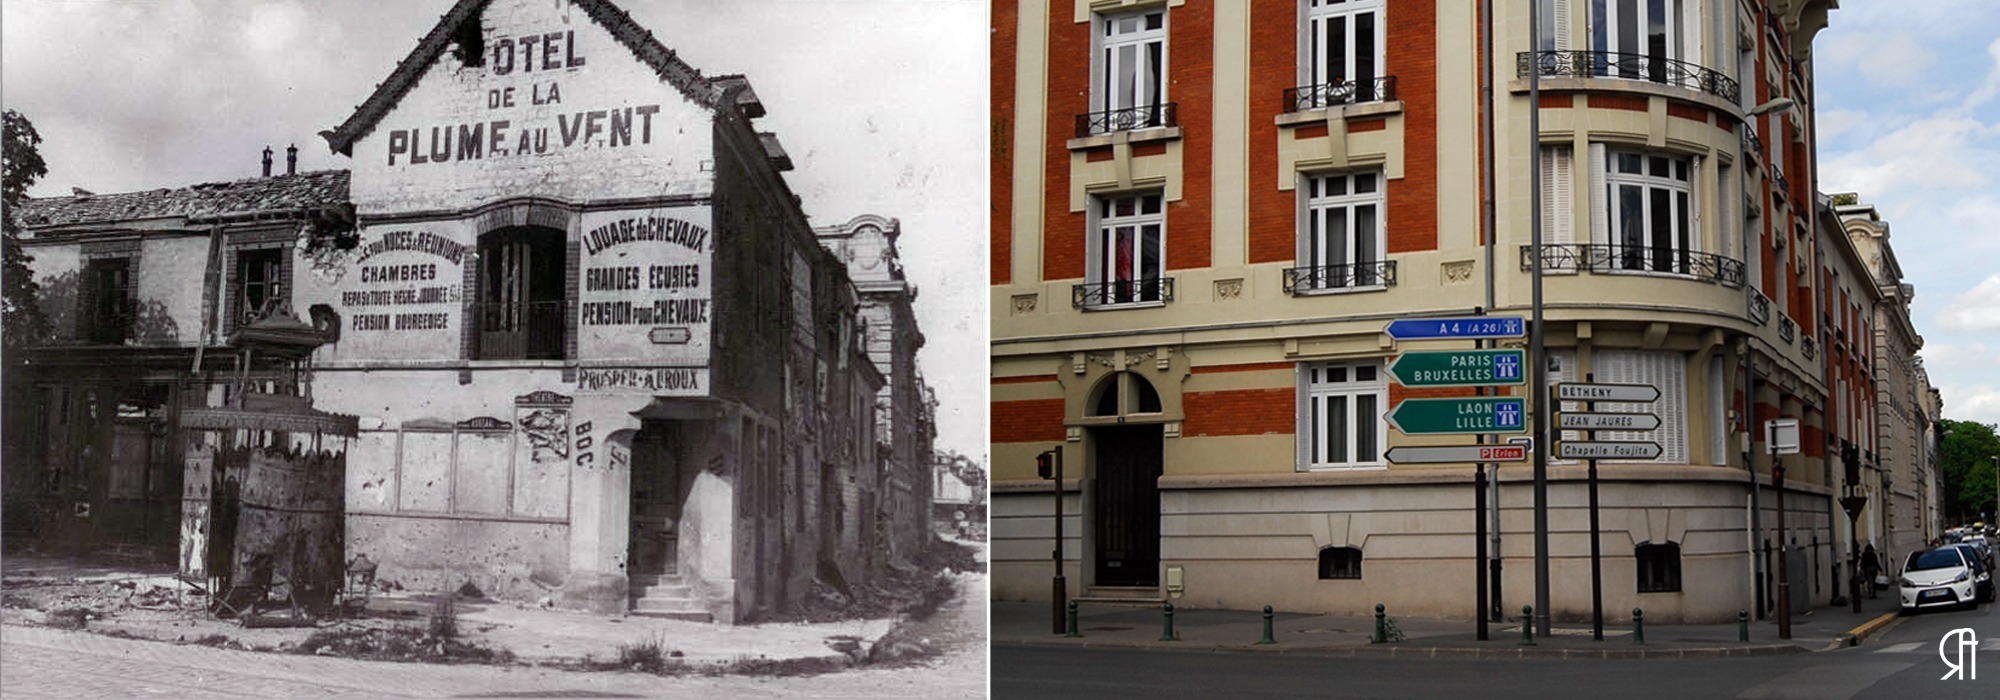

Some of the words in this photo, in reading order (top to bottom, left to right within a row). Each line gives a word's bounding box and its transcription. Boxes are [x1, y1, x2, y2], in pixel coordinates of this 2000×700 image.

[488, 87, 516, 109] DE
[532, 82, 561, 105] LA
[388, 120, 510, 166] PLUME
[517, 127, 548, 155] AU
[558, 104, 660, 149] VENT
[583, 219, 637, 256] LOUAGE
[647, 216, 709, 253] CHEVAUX
[361, 264, 436, 282] CHAMBRES
[586, 266, 640, 291] GRANDES
[649, 263, 700, 289] ÉCURIES
[582, 301, 632, 325] PENSION
[653, 299, 707, 324] CHEVAUX
[353, 314, 390, 331] PENSION
[1439, 323, 1448, 334] A
[1451, 323, 1460, 333] 4
[1451, 355, 1491, 366] PARIS
[1414, 369, 1491, 382] BRUXELLES
[1562, 387, 1612, 397] BÉTHENY
[1458, 403, 1492, 415] LAON
[1456, 416, 1492, 428] LILLE
[1564, 417, 1589, 427] JEAN
[1564, 446, 1608, 456] Chapelle
[1613, 445, 1648, 457] Foujita
